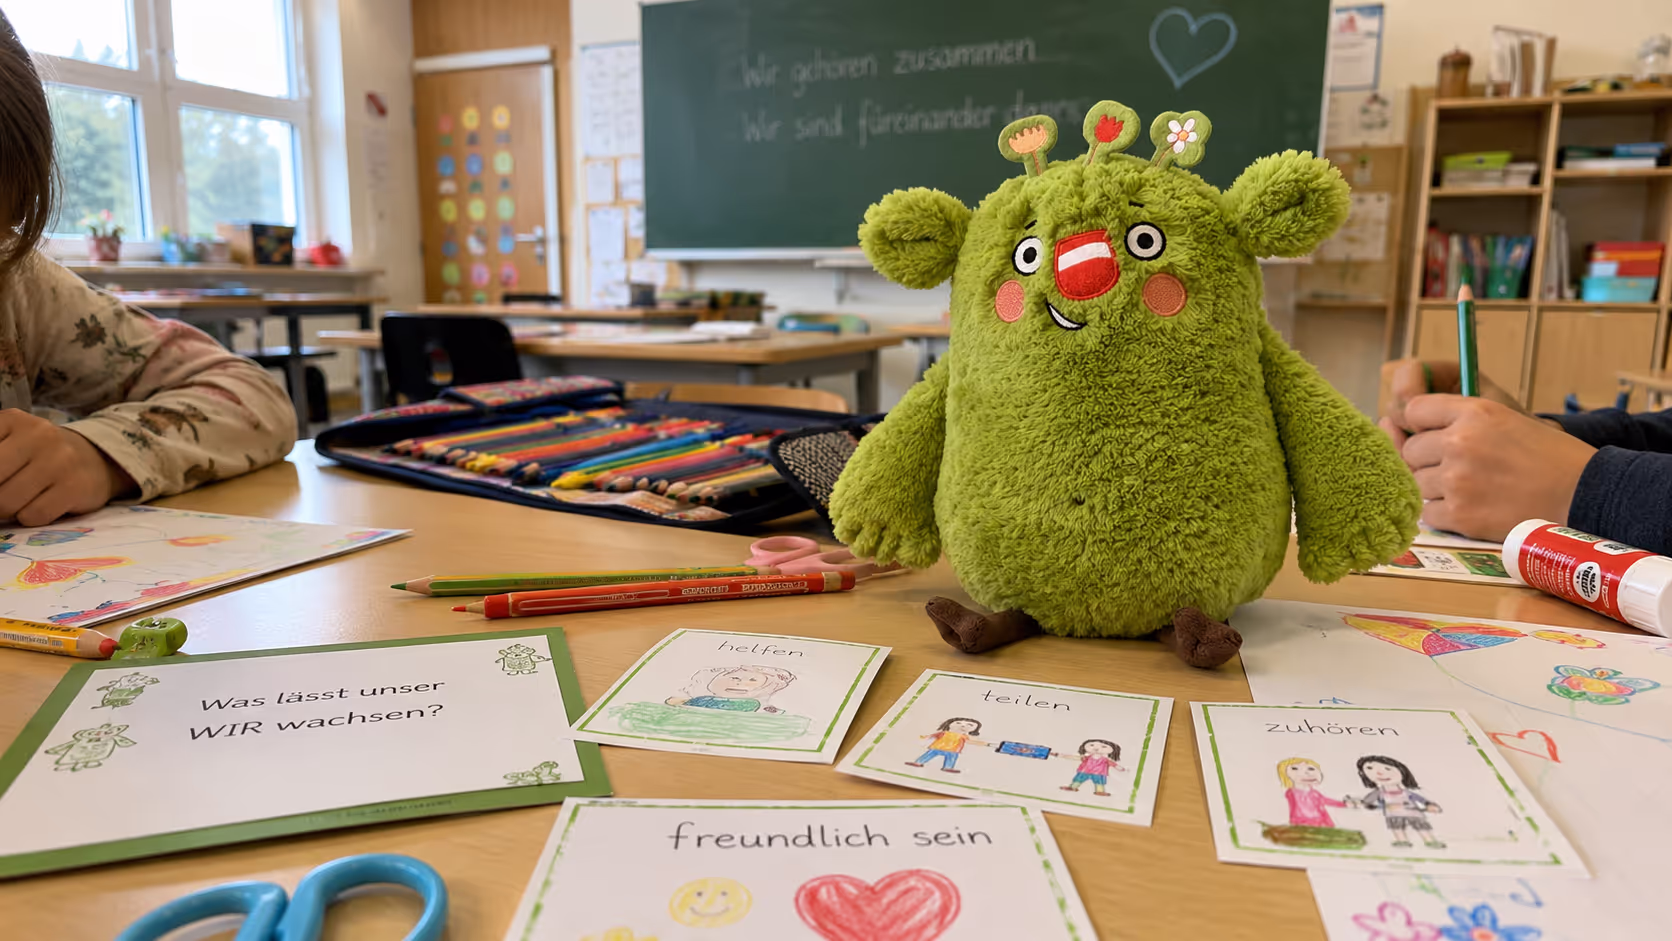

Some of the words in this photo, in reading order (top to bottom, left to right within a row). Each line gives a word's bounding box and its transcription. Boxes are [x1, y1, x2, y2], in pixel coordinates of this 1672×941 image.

[741, 51, 780, 88] Wir
[893, 37, 1037, 74] zusammen
[741, 109, 784, 142] Wir
[796, 103, 843, 140] sind
[859, 97, 995, 149] füreinander
[717, 640, 804, 657] helfen
[201, 697, 265, 711] Was
[276, 688, 349, 705] lässt
[360, 681, 445, 698] unser
[981, 688, 1071, 712] teilen
[189, 720, 263, 740] WIR
[276, 704, 444, 731] wachsen?
[1265, 719, 1399, 738] zuhören
[668, 821, 890, 850] freundlich
[913, 826, 993, 848] sein
